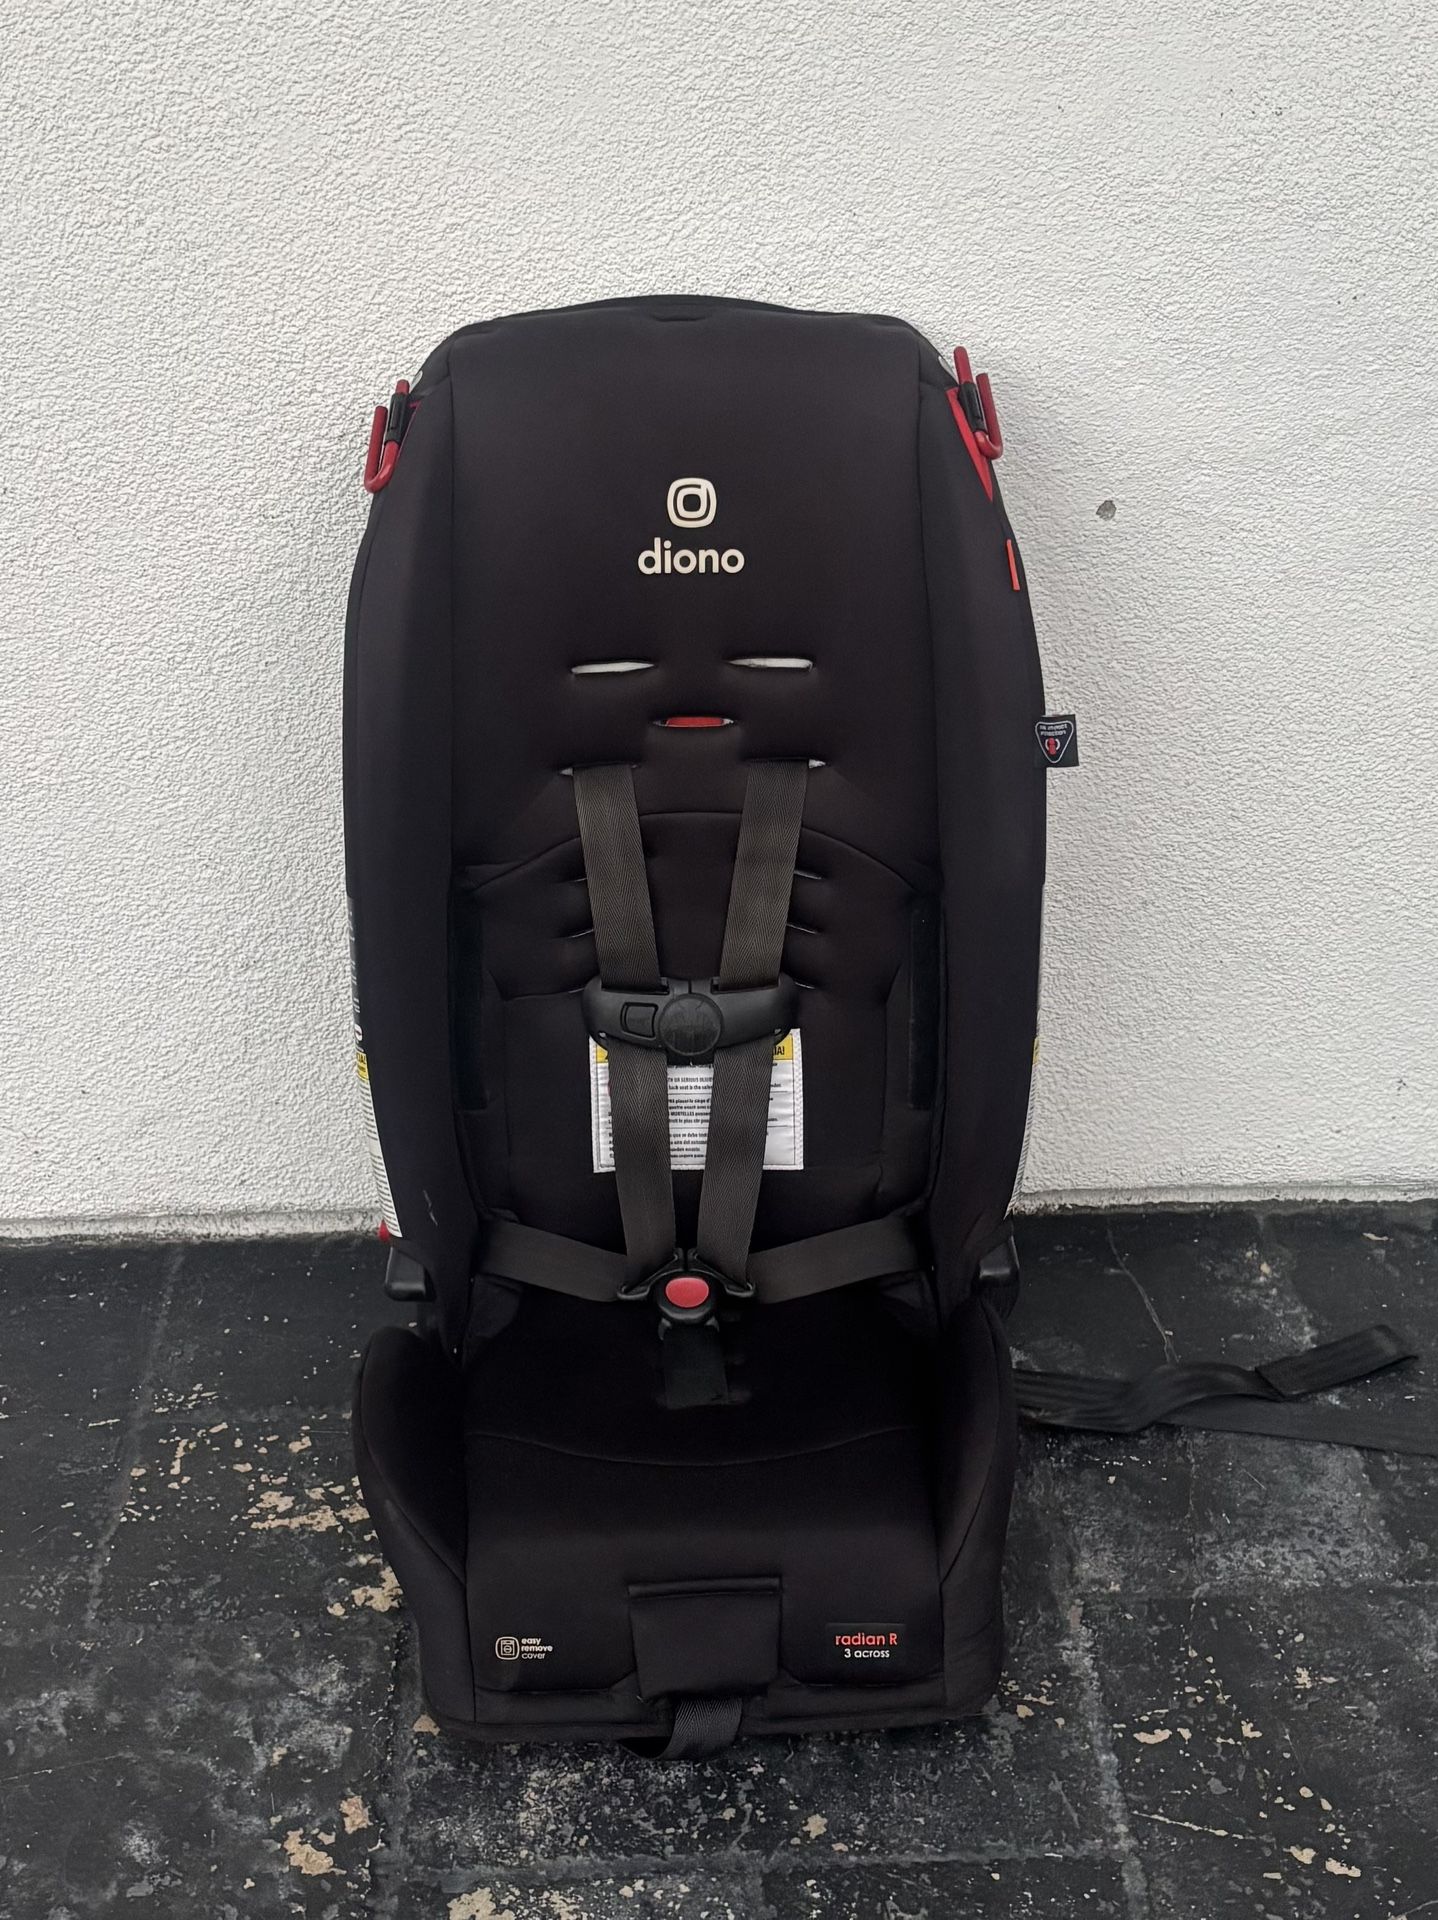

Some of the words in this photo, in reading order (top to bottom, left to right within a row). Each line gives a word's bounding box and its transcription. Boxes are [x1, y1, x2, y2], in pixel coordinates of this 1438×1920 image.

[638, 537, 745, 575] diono
[835, 1632, 885, 1646] radian
[889, 1633, 898, 1646] R
[844, 1648, 852, 1658] 3
[854, 1650, 890, 1658] across
